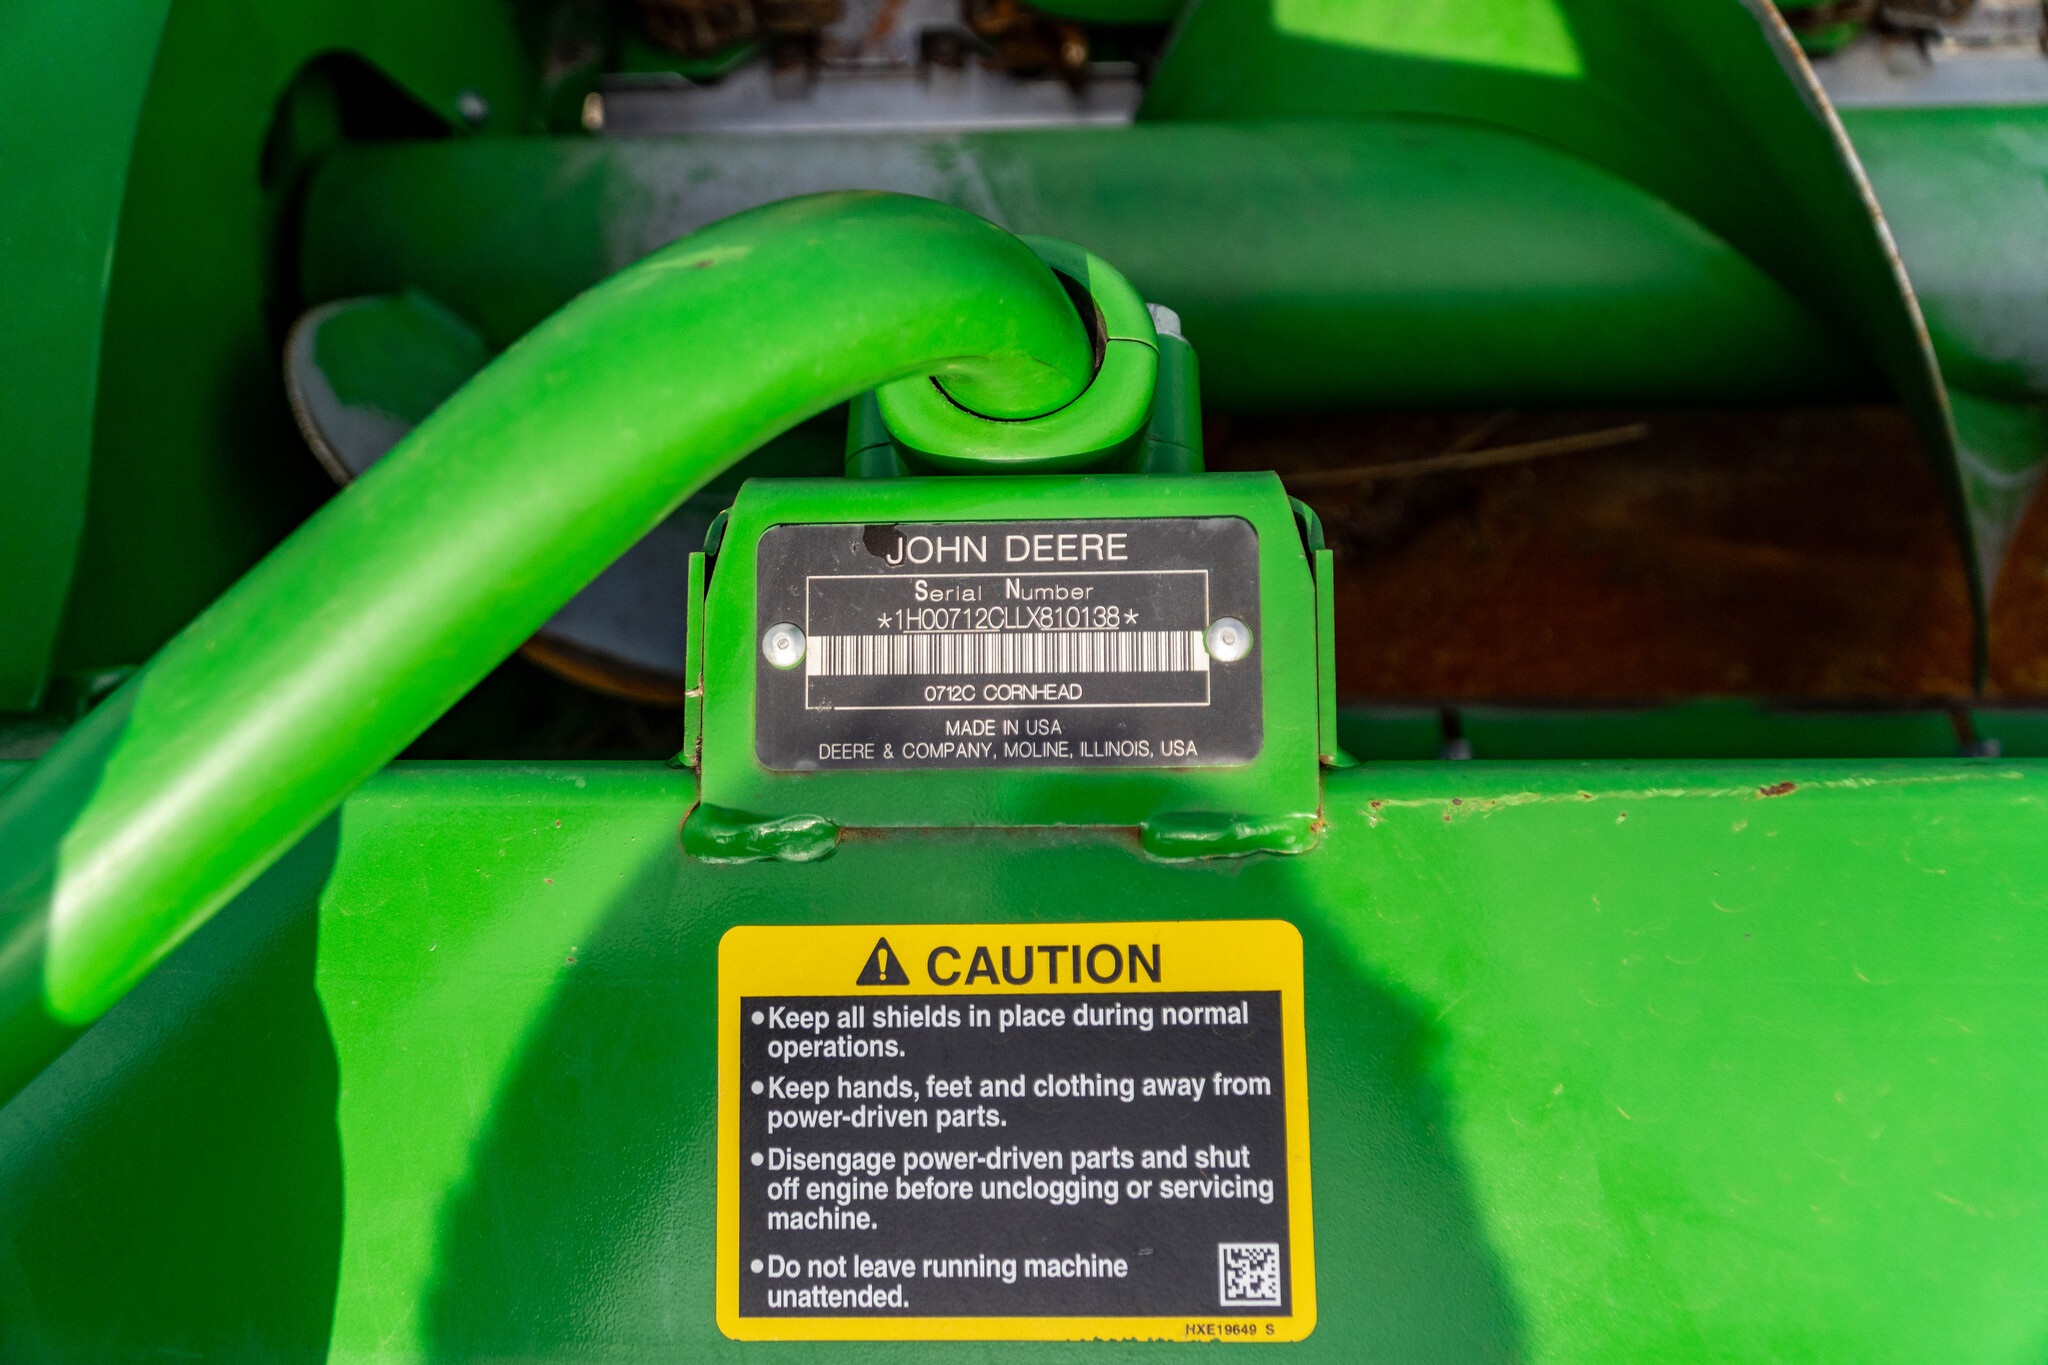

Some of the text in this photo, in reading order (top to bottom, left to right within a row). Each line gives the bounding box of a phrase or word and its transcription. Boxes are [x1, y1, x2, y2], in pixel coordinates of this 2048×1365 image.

[887, 534, 1127, 563] JOHN DEERE
[915, 578, 1093, 601] Serial Number
[925, 684, 1082, 701] 0712C CORNHEAD
[946, 719, 1061, 736] MADE IN USA
[820, 740, 1197, 759] DEERE & COMPANY, MOLINE, ILLINOIS, USA
[928, 944, 1161, 986] CAUTION
[770, 1001, 1248, 1034] Keep all shields in place during normal
[768, 1035, 905, 1063] operations.
[769, 1072, 1270, 1104] Keep hands, feet and clothing away from
[769, 1103, 1006, 1134] power-driven parts.
[769, 1145, 1250, 1176] Disengage power-driven parts and shut
[768, 1174, 1273, 1207] off engine before unclogging or servicing
[768, 1205, 877, 1229] machine.
[769, 1254, 1128, 1283] Do not leave running machine
[768, 1284, 908, 1308] unattended.
[1186, 1324, 1274, 1336] HXE19649 S
